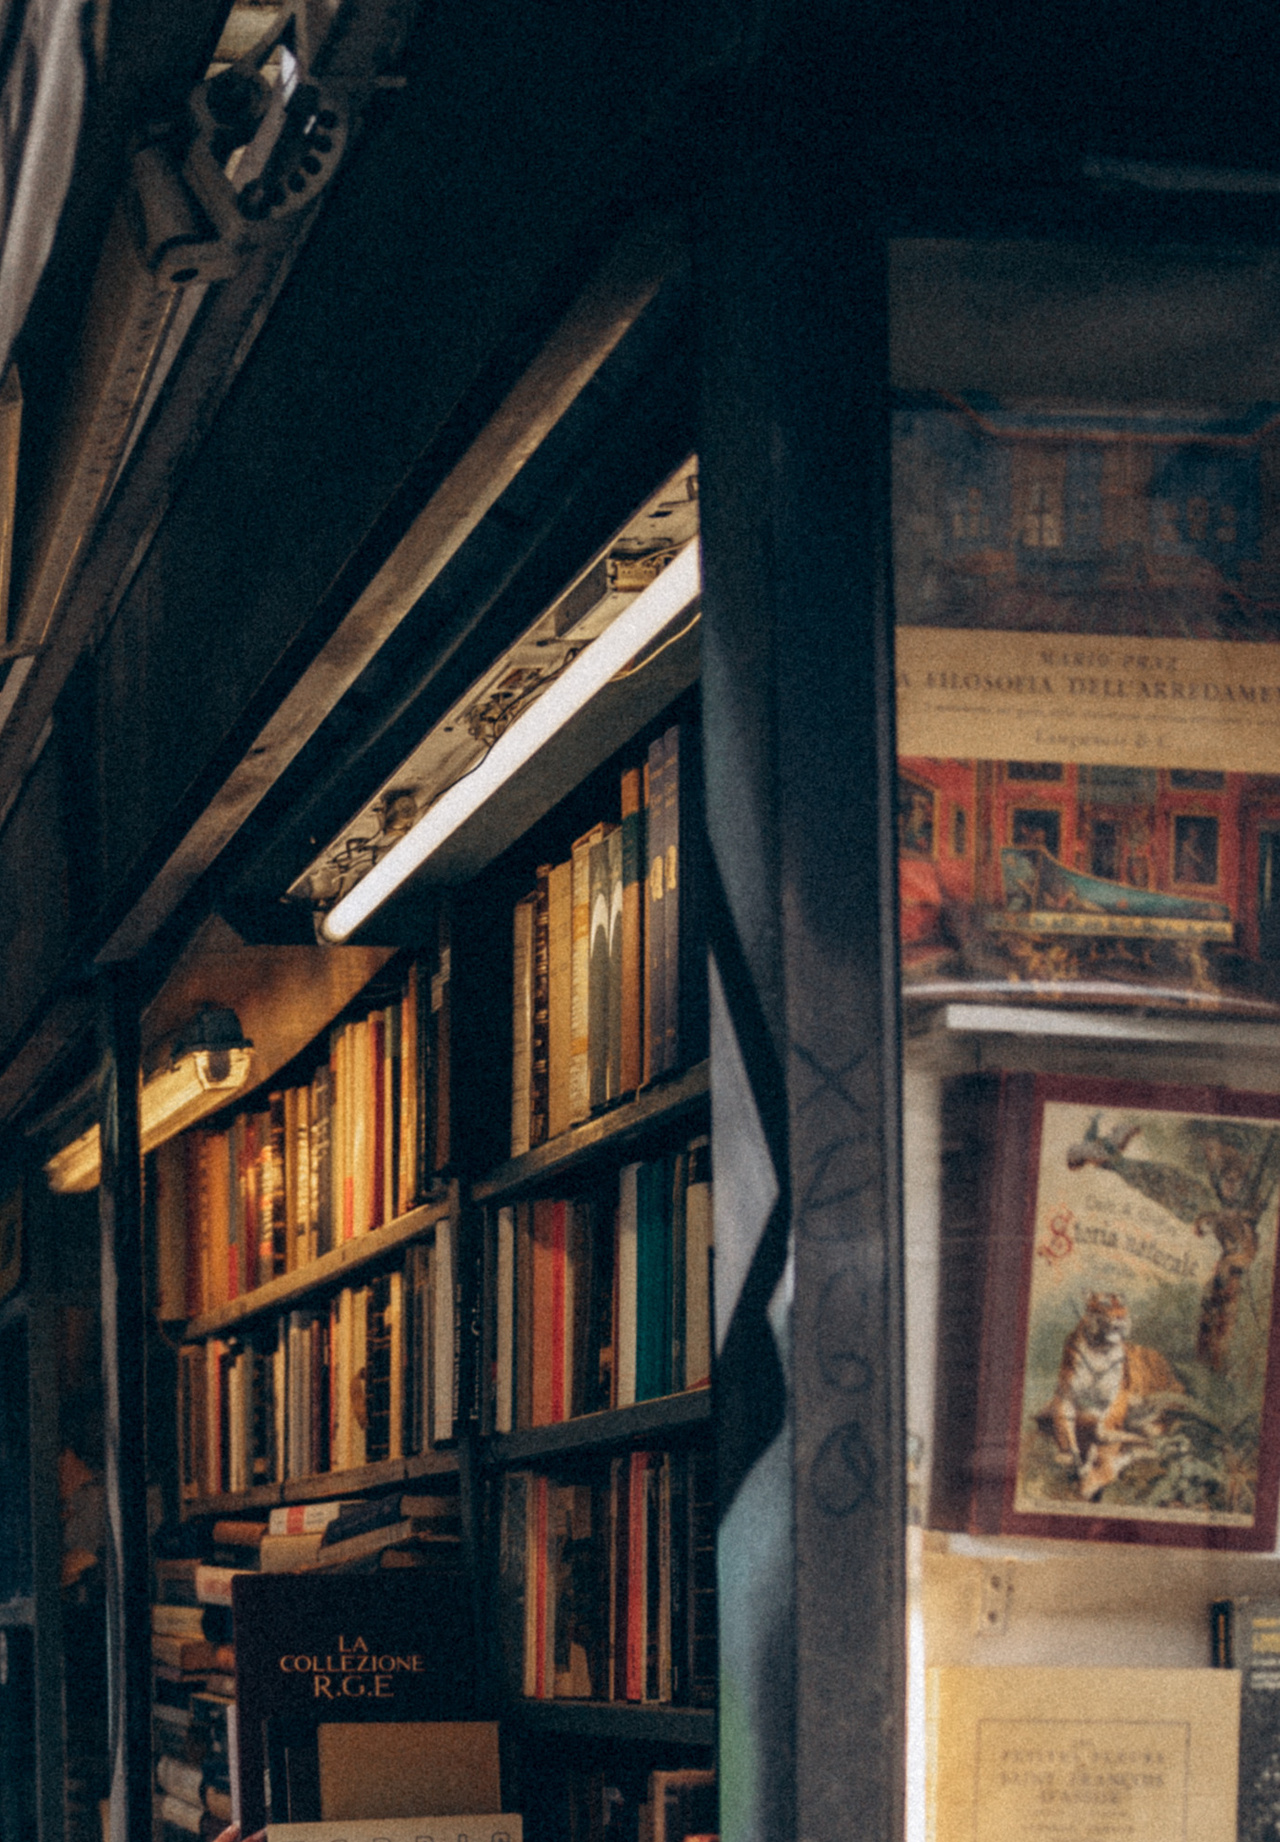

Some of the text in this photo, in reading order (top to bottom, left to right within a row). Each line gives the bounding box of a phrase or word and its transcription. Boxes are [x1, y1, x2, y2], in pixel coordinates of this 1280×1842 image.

[924, 671, 1054, 695] FILOSOFIA
[337, 1634, 369, 1653] LA
[279, 1654, 426, 1673] COLLEZIONE
[313, 1674, 395, 1700] R.G.E
